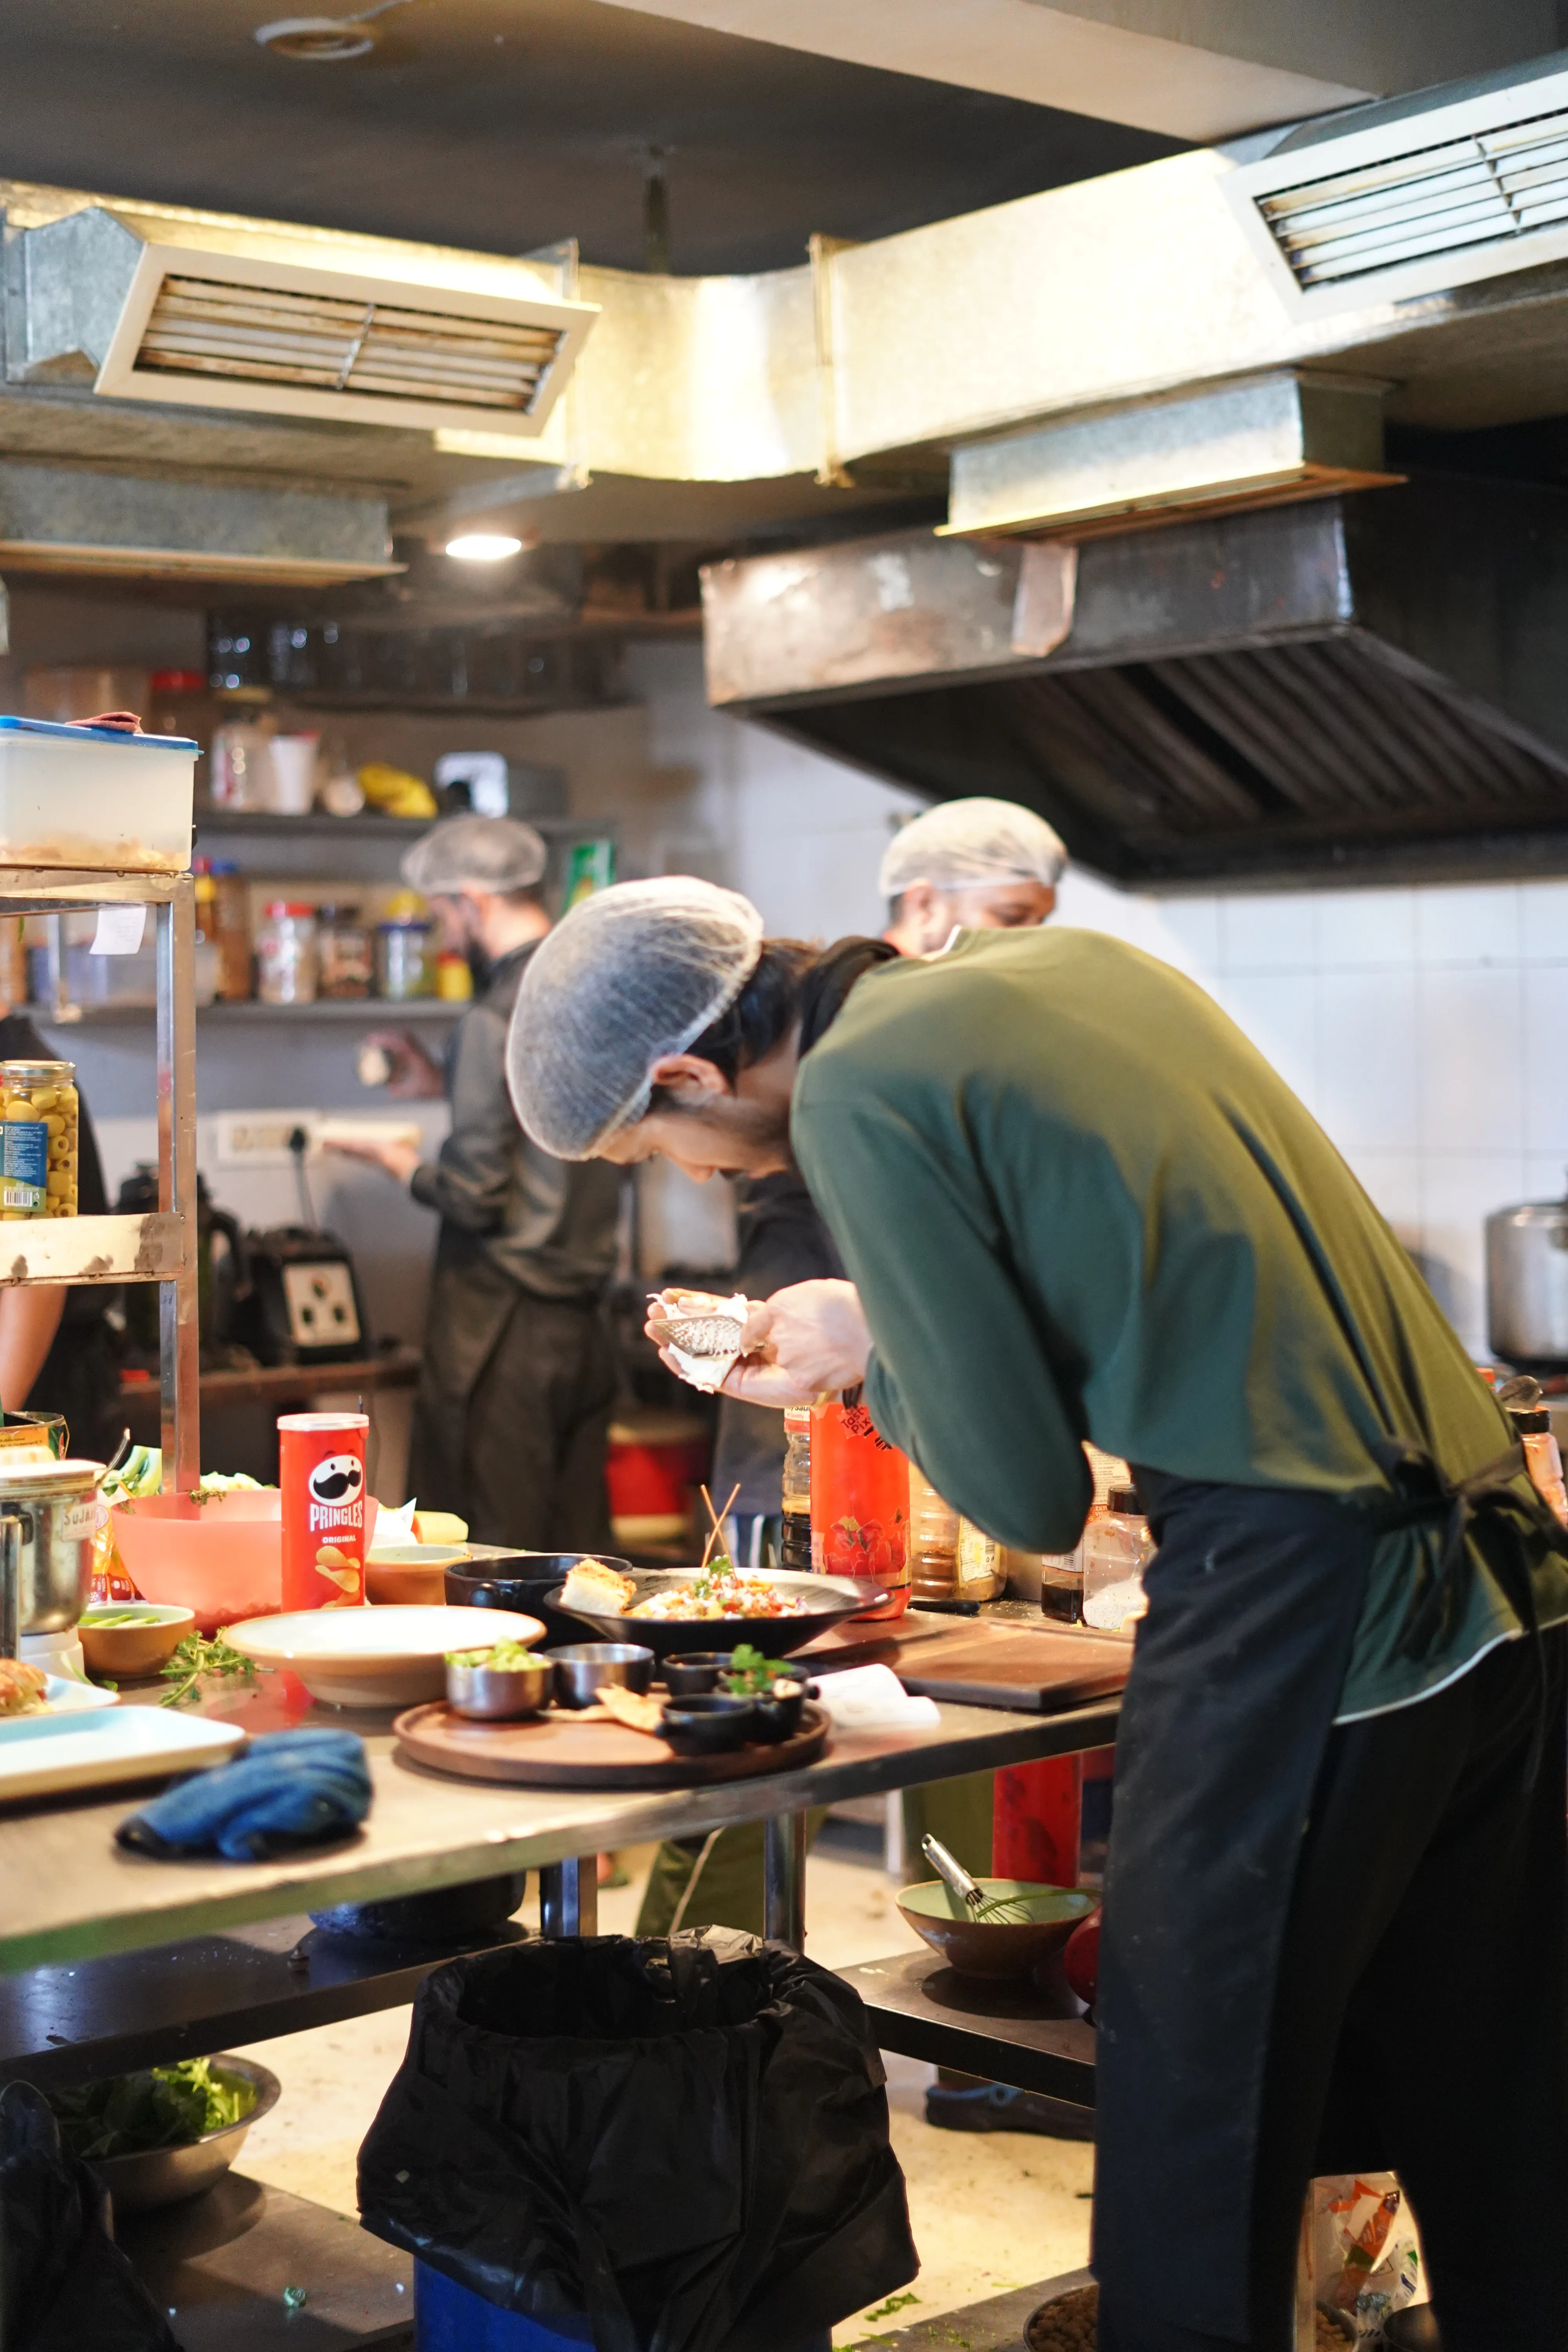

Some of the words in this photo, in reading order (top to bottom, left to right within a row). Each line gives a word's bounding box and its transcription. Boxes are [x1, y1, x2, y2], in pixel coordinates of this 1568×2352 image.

[851, 1417, 871, 1434] Pix
[310, 1500, 363, 1532] PRINGLES
[322, 1535, 356, 1544] ORIGINAL
